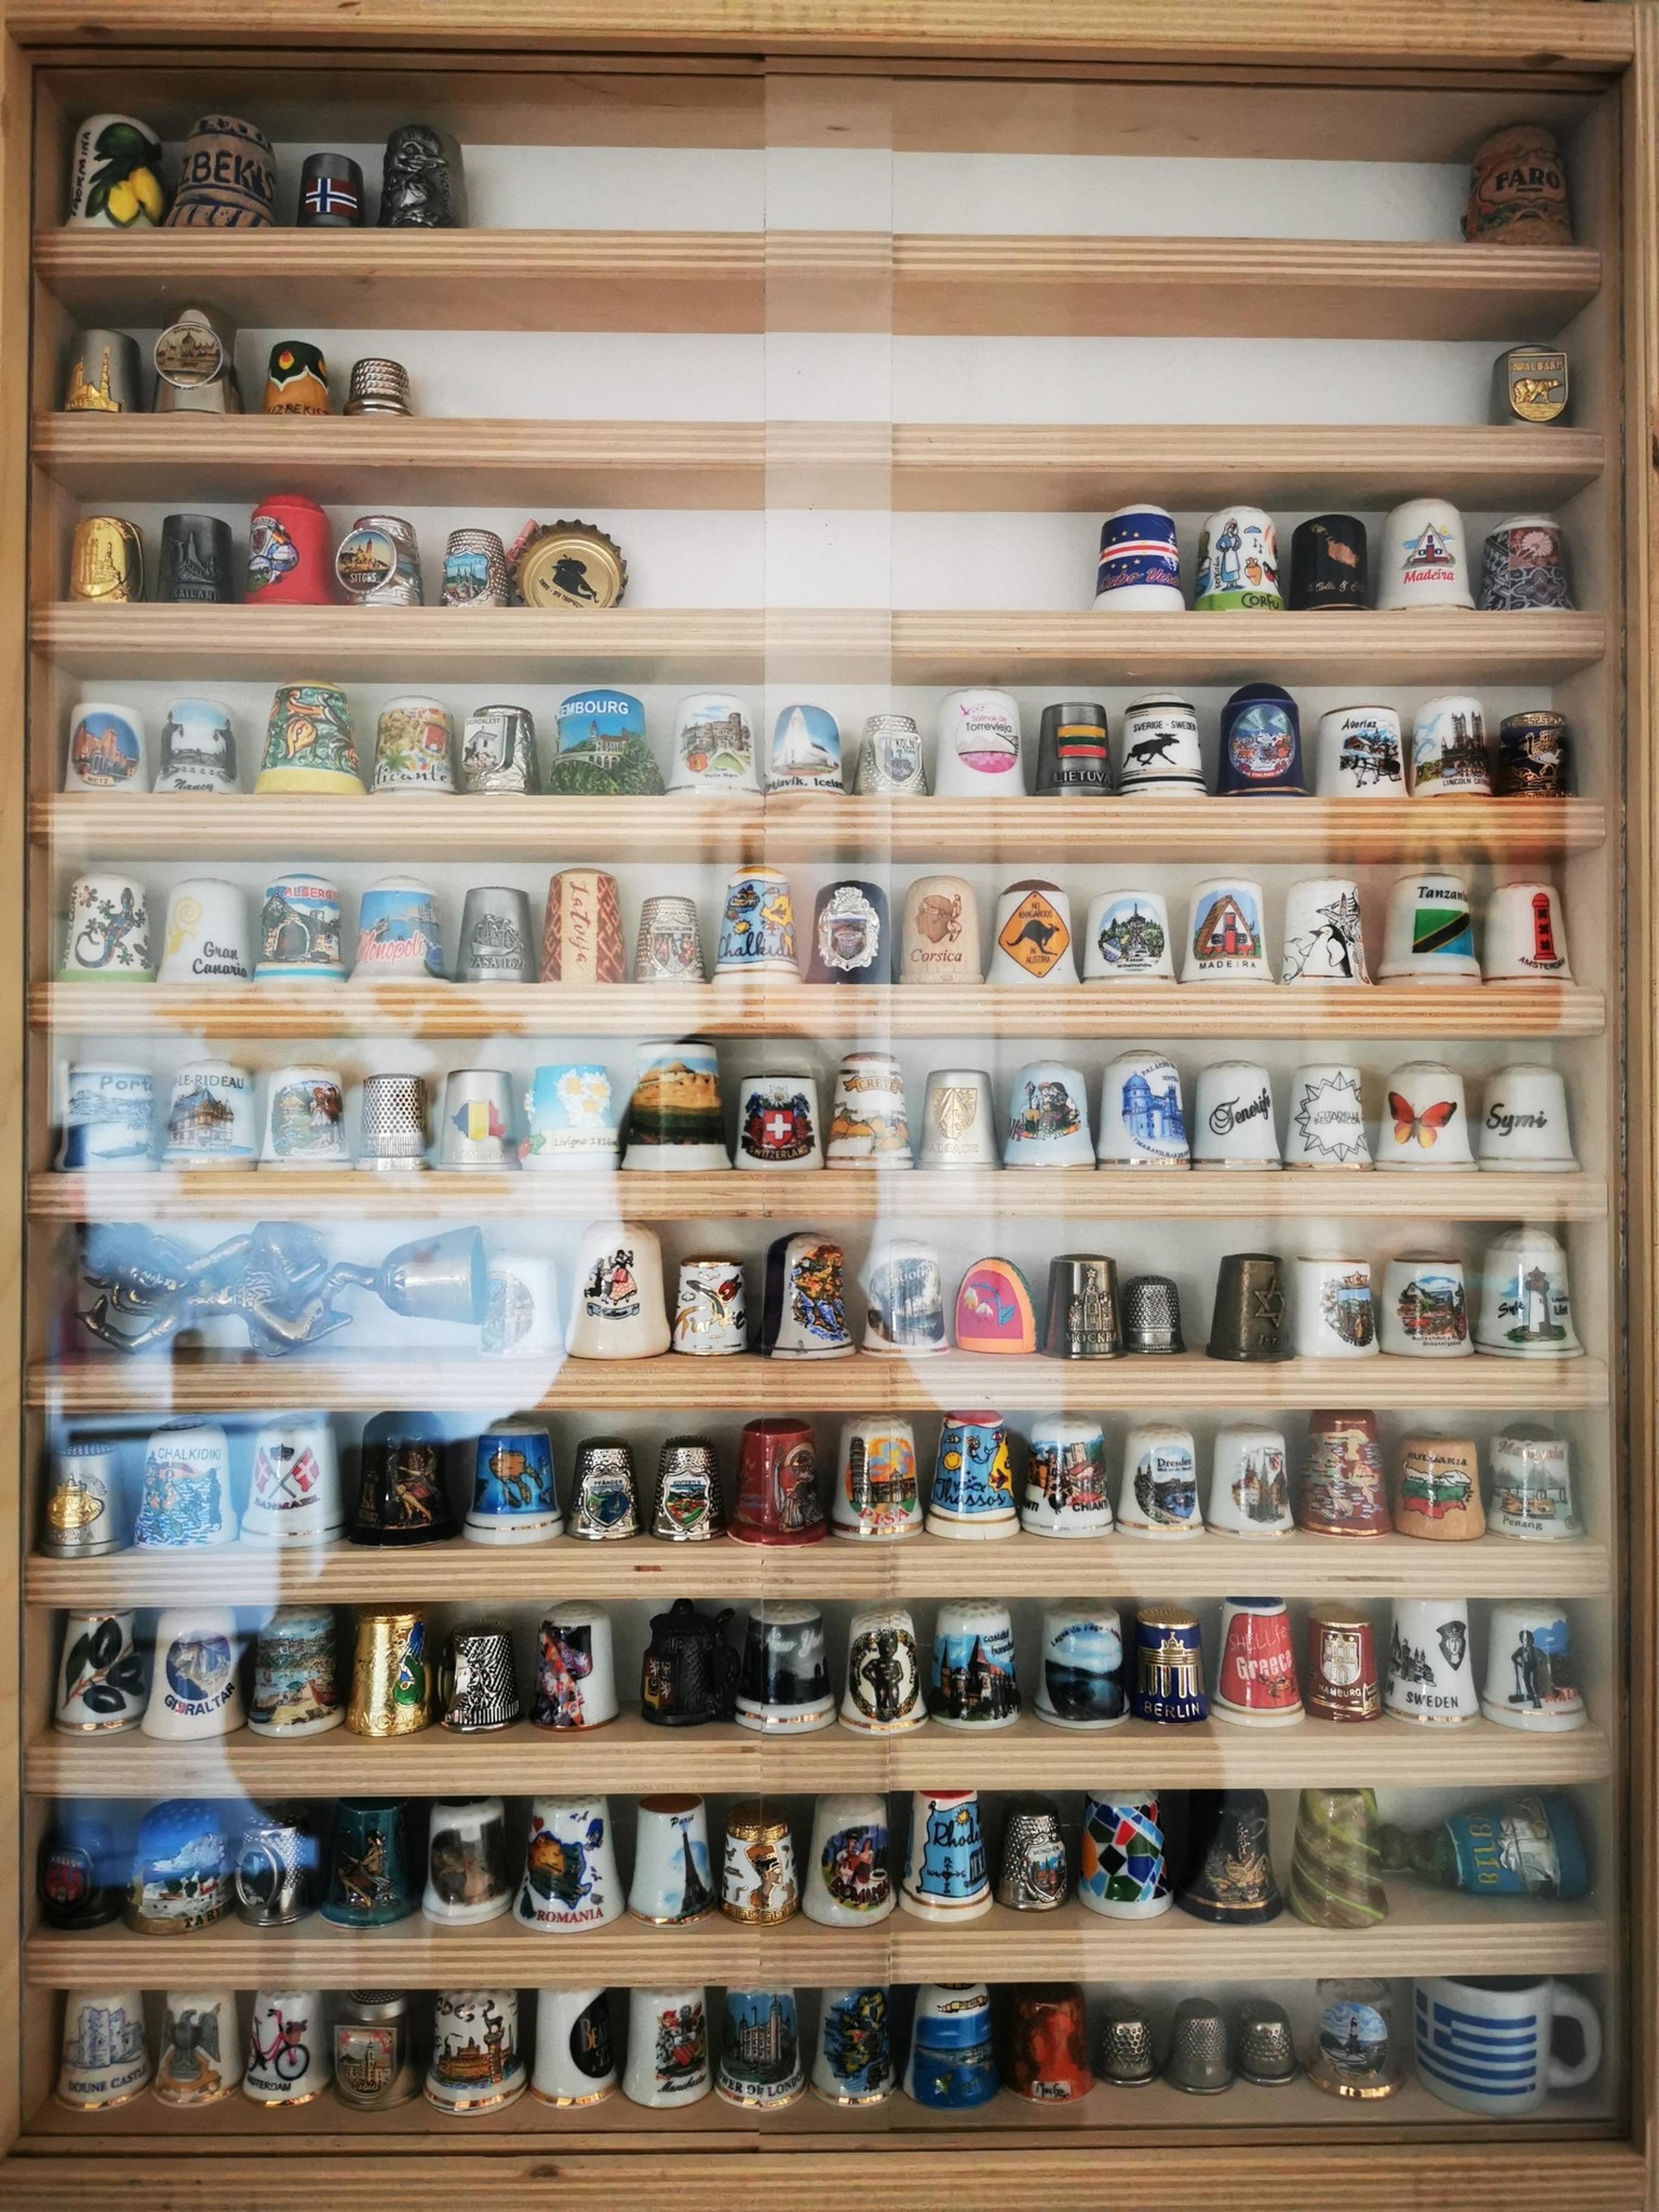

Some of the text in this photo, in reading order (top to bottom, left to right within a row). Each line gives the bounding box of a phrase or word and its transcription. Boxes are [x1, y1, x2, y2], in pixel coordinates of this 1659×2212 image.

[1494, 167, 1560, 193] FARO
[349, 572, 381, 585] SITGES
[1403, 568, 1455, 585] Madeira
[465, 717, 501, 726] GUADALEST
[966, 722, 1012, 734] Torrevieja
[1133, 720, 1163, 734] SVERIGE
[1170, 720, 1197, 731] SWEDEN
[1341, 718, 1377, 731] Avoriaz
[174, 778, 214, 792] Nancy
[1442, 778, 1472, 787] LINCOLN
[1018, 909, 1054, 919] KANGAROOS
[569, 880, 592, 971] Latvija
[203, 941, 238, 959] Gran
[358, 930, 427, 966] Monopoli
[910, 948, 963, 963] Corsica
[192, 958, 248, 977] Canaria
[1026, 956, 1051, 964] AUSTRIA
[1198, 960, 1257, 970] MADEIRA
[1518, 956, 1567, 970] AMSTERDAM
[857, 1079, 897, 1091] CRETE
[1486, 1103, 1548, 1137] Symi
[554, 1139, 587, 1149] Livigno
[748, 1144, 809, 1159] SWITZERLAND
[158, 1446, 221, 1460] CHALKIDIKI
[1157, 1456, 1192, 1467] Dresden
[934, 1476, 1006, 1506] Thassos
[1072, 1500, 1109, 1513] CHIANTI
[858, 1506, 910, 1526] PISA
[1503, 1515, 1543, 1531] Penang
[1236, 1649, 1292, 1680] Greece
[1318, 1683, 1361, 1698] HAMBURG
[164, 1681, 235, 1716] GIBRALTAR
[1405, 1691, 1459, 1709] SWEDEN
[1144, 1700, 1200, 1719] BERLIN
[671, 1814, 694, 1828] Paris
[536, 1909, 604, 1924] ROMANIA
[658, 2075, 707, 2093] Manchester
